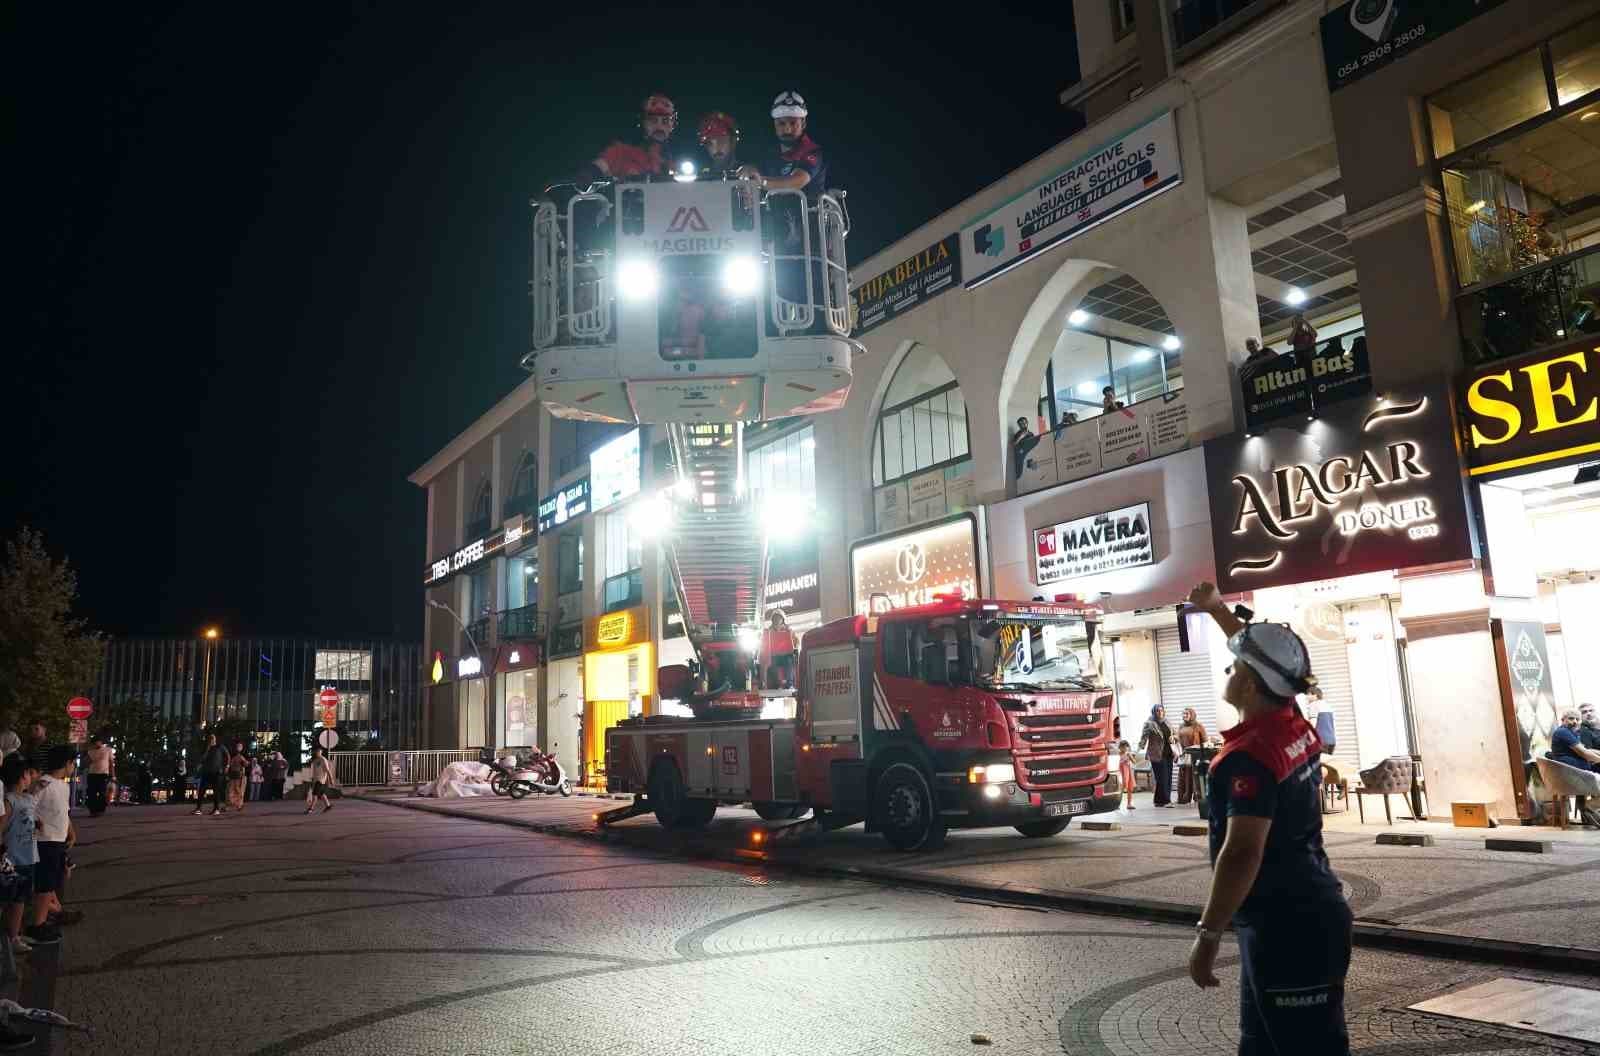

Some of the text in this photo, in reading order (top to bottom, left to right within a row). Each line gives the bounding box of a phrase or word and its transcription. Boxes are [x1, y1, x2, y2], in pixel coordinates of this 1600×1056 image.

[1016, 142, 1156, 228] LANGUAGE SCHOOLS
[1038, 142, 1125, 200] INTERACTIVE
[1312, 351, 1355, 377] Baş
[1468, 346, 1600, 449] SE
[1231, 441, 1431, 541] ALAGAR
[1062, 513, 1148, 551] MAVERA
[1339, 498, 1434, 534] DÖNER
[454, 538, 484, 571] COFFEE
